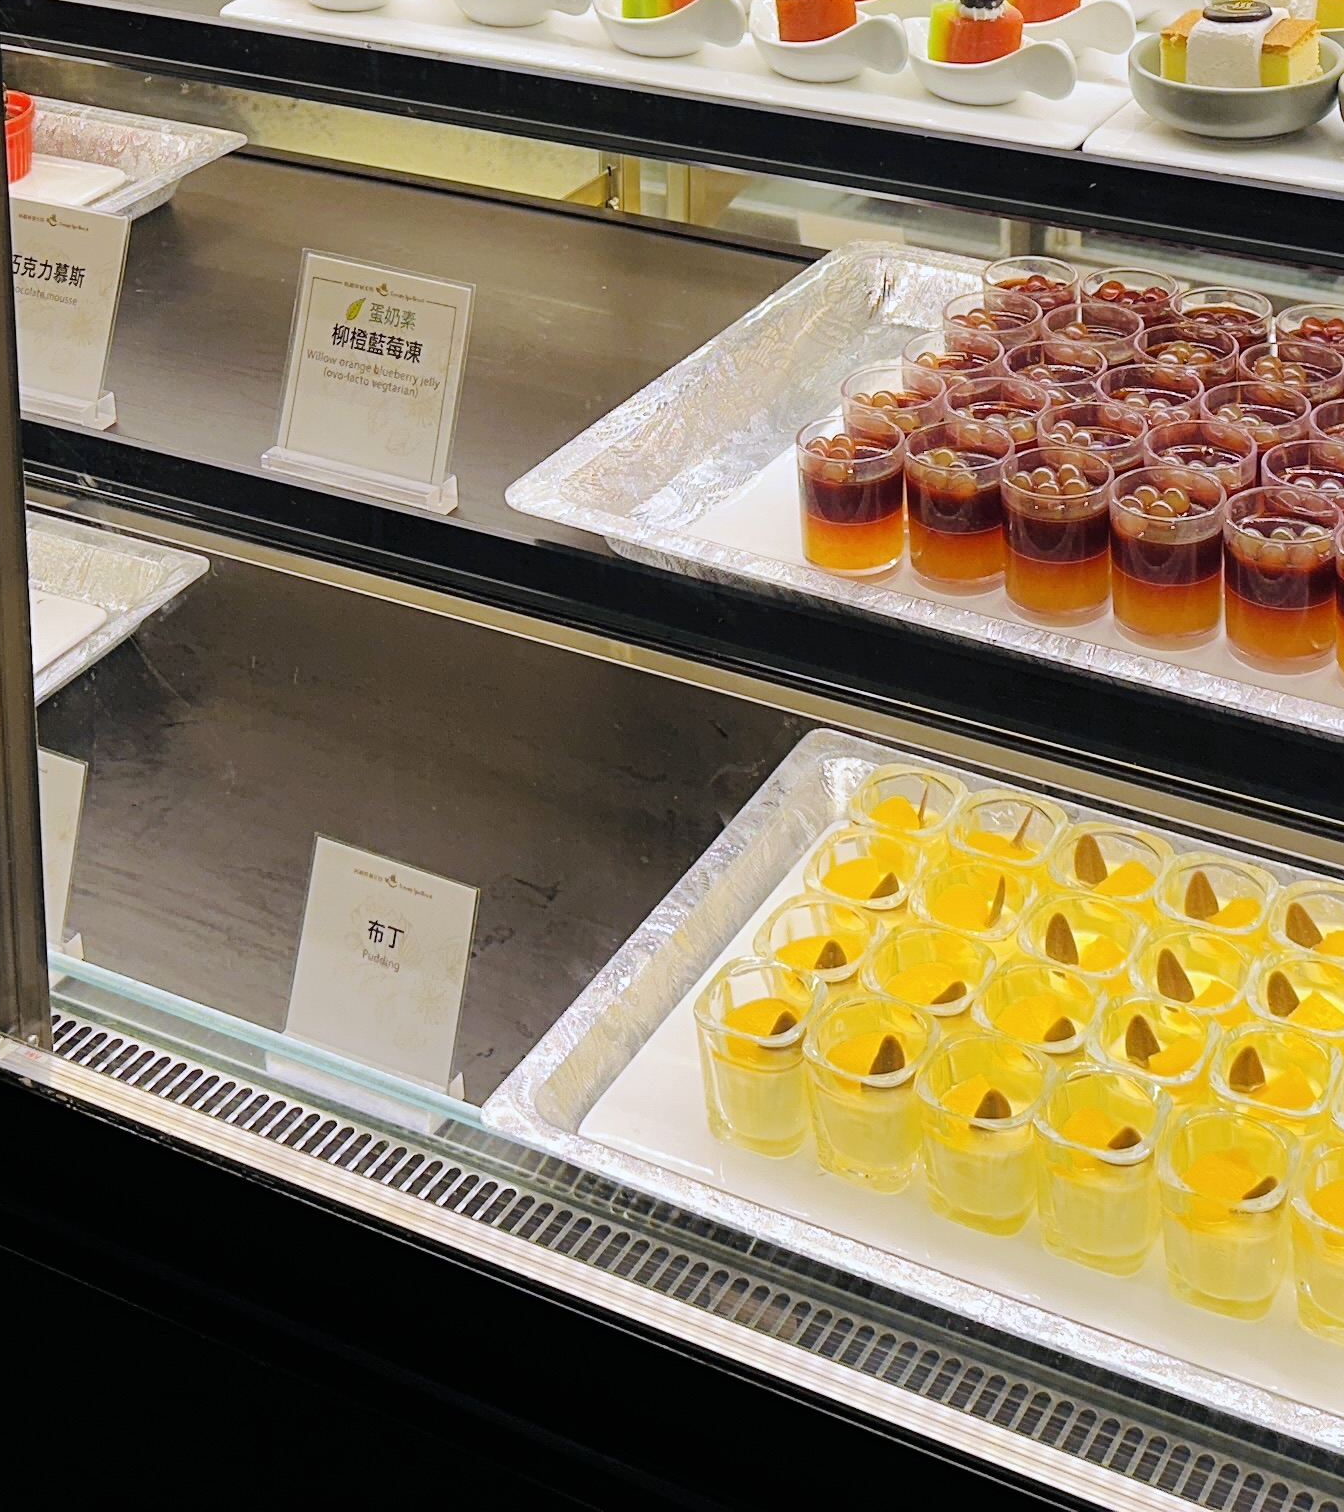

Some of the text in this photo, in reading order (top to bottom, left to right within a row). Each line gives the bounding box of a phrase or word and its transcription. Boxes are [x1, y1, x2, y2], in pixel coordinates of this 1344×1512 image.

[15, 285, 45, 299] ocolate
[368, 301, 416, 331] 蛋奶素
[331, 322, 424, 364] 柳橙藍莓凍
[307, 348, 441, 391] Willow orange blueberry jelly
[367, 919, 405, 949] 布丁
[361, 948, 401, 973] Pudding
